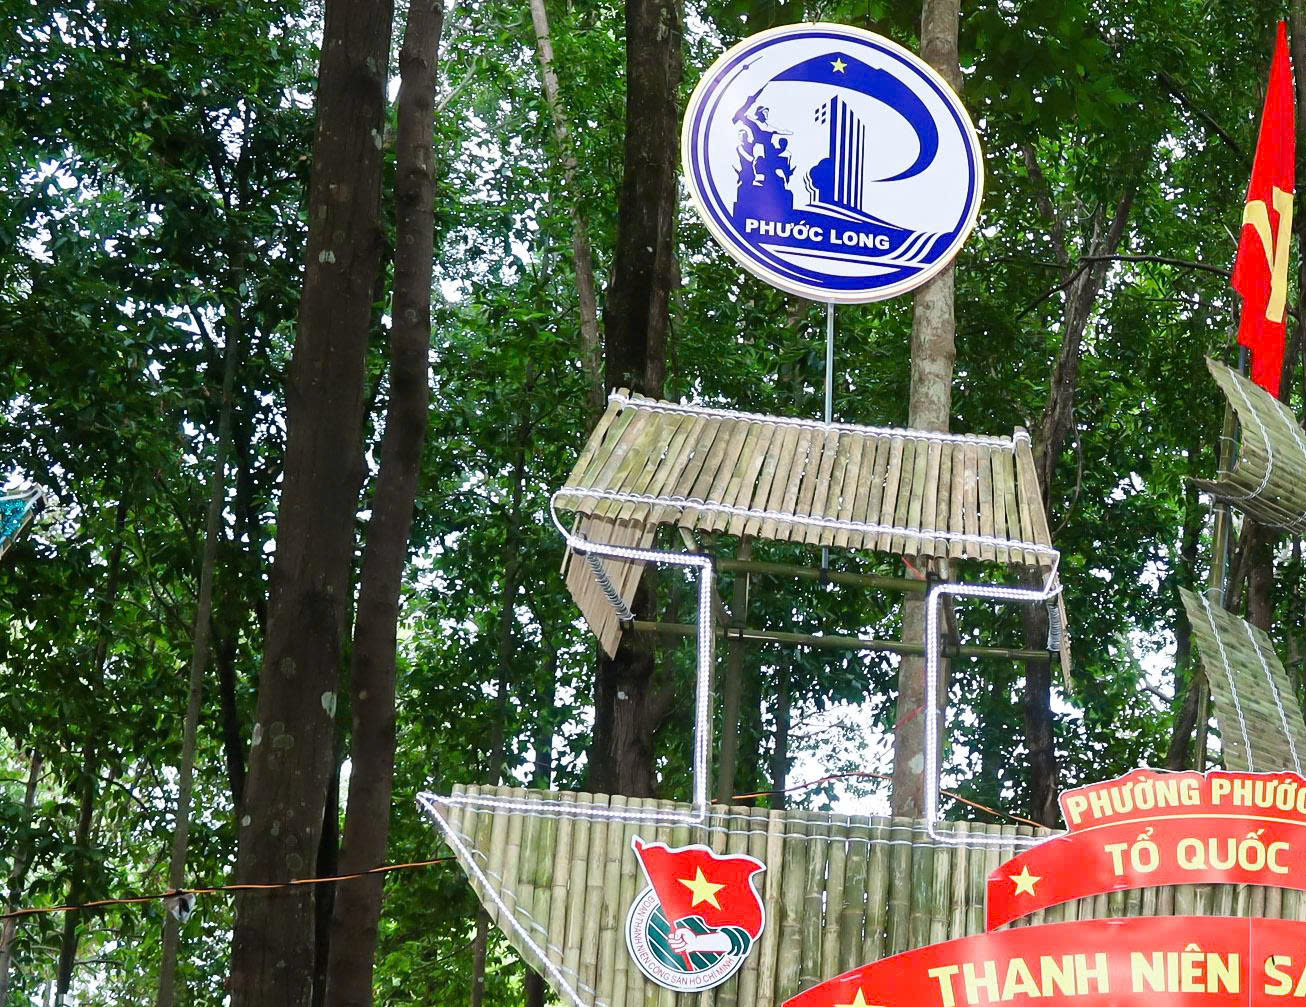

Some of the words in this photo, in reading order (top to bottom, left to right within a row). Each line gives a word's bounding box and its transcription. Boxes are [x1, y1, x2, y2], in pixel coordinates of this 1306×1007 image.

[745, 218, 823, 242] PHƯỚC
[830, 229, 890, 250] LONG
[1066, 778, 1201, 824] PHƯỜNG
[1104, 827, 1160, 876] TỔ
[1177, 829, 1289, 874] QUỐC
[928, 954, 1110, 1007] THANH
[1130, 950, 1240, 996] NIÊN
